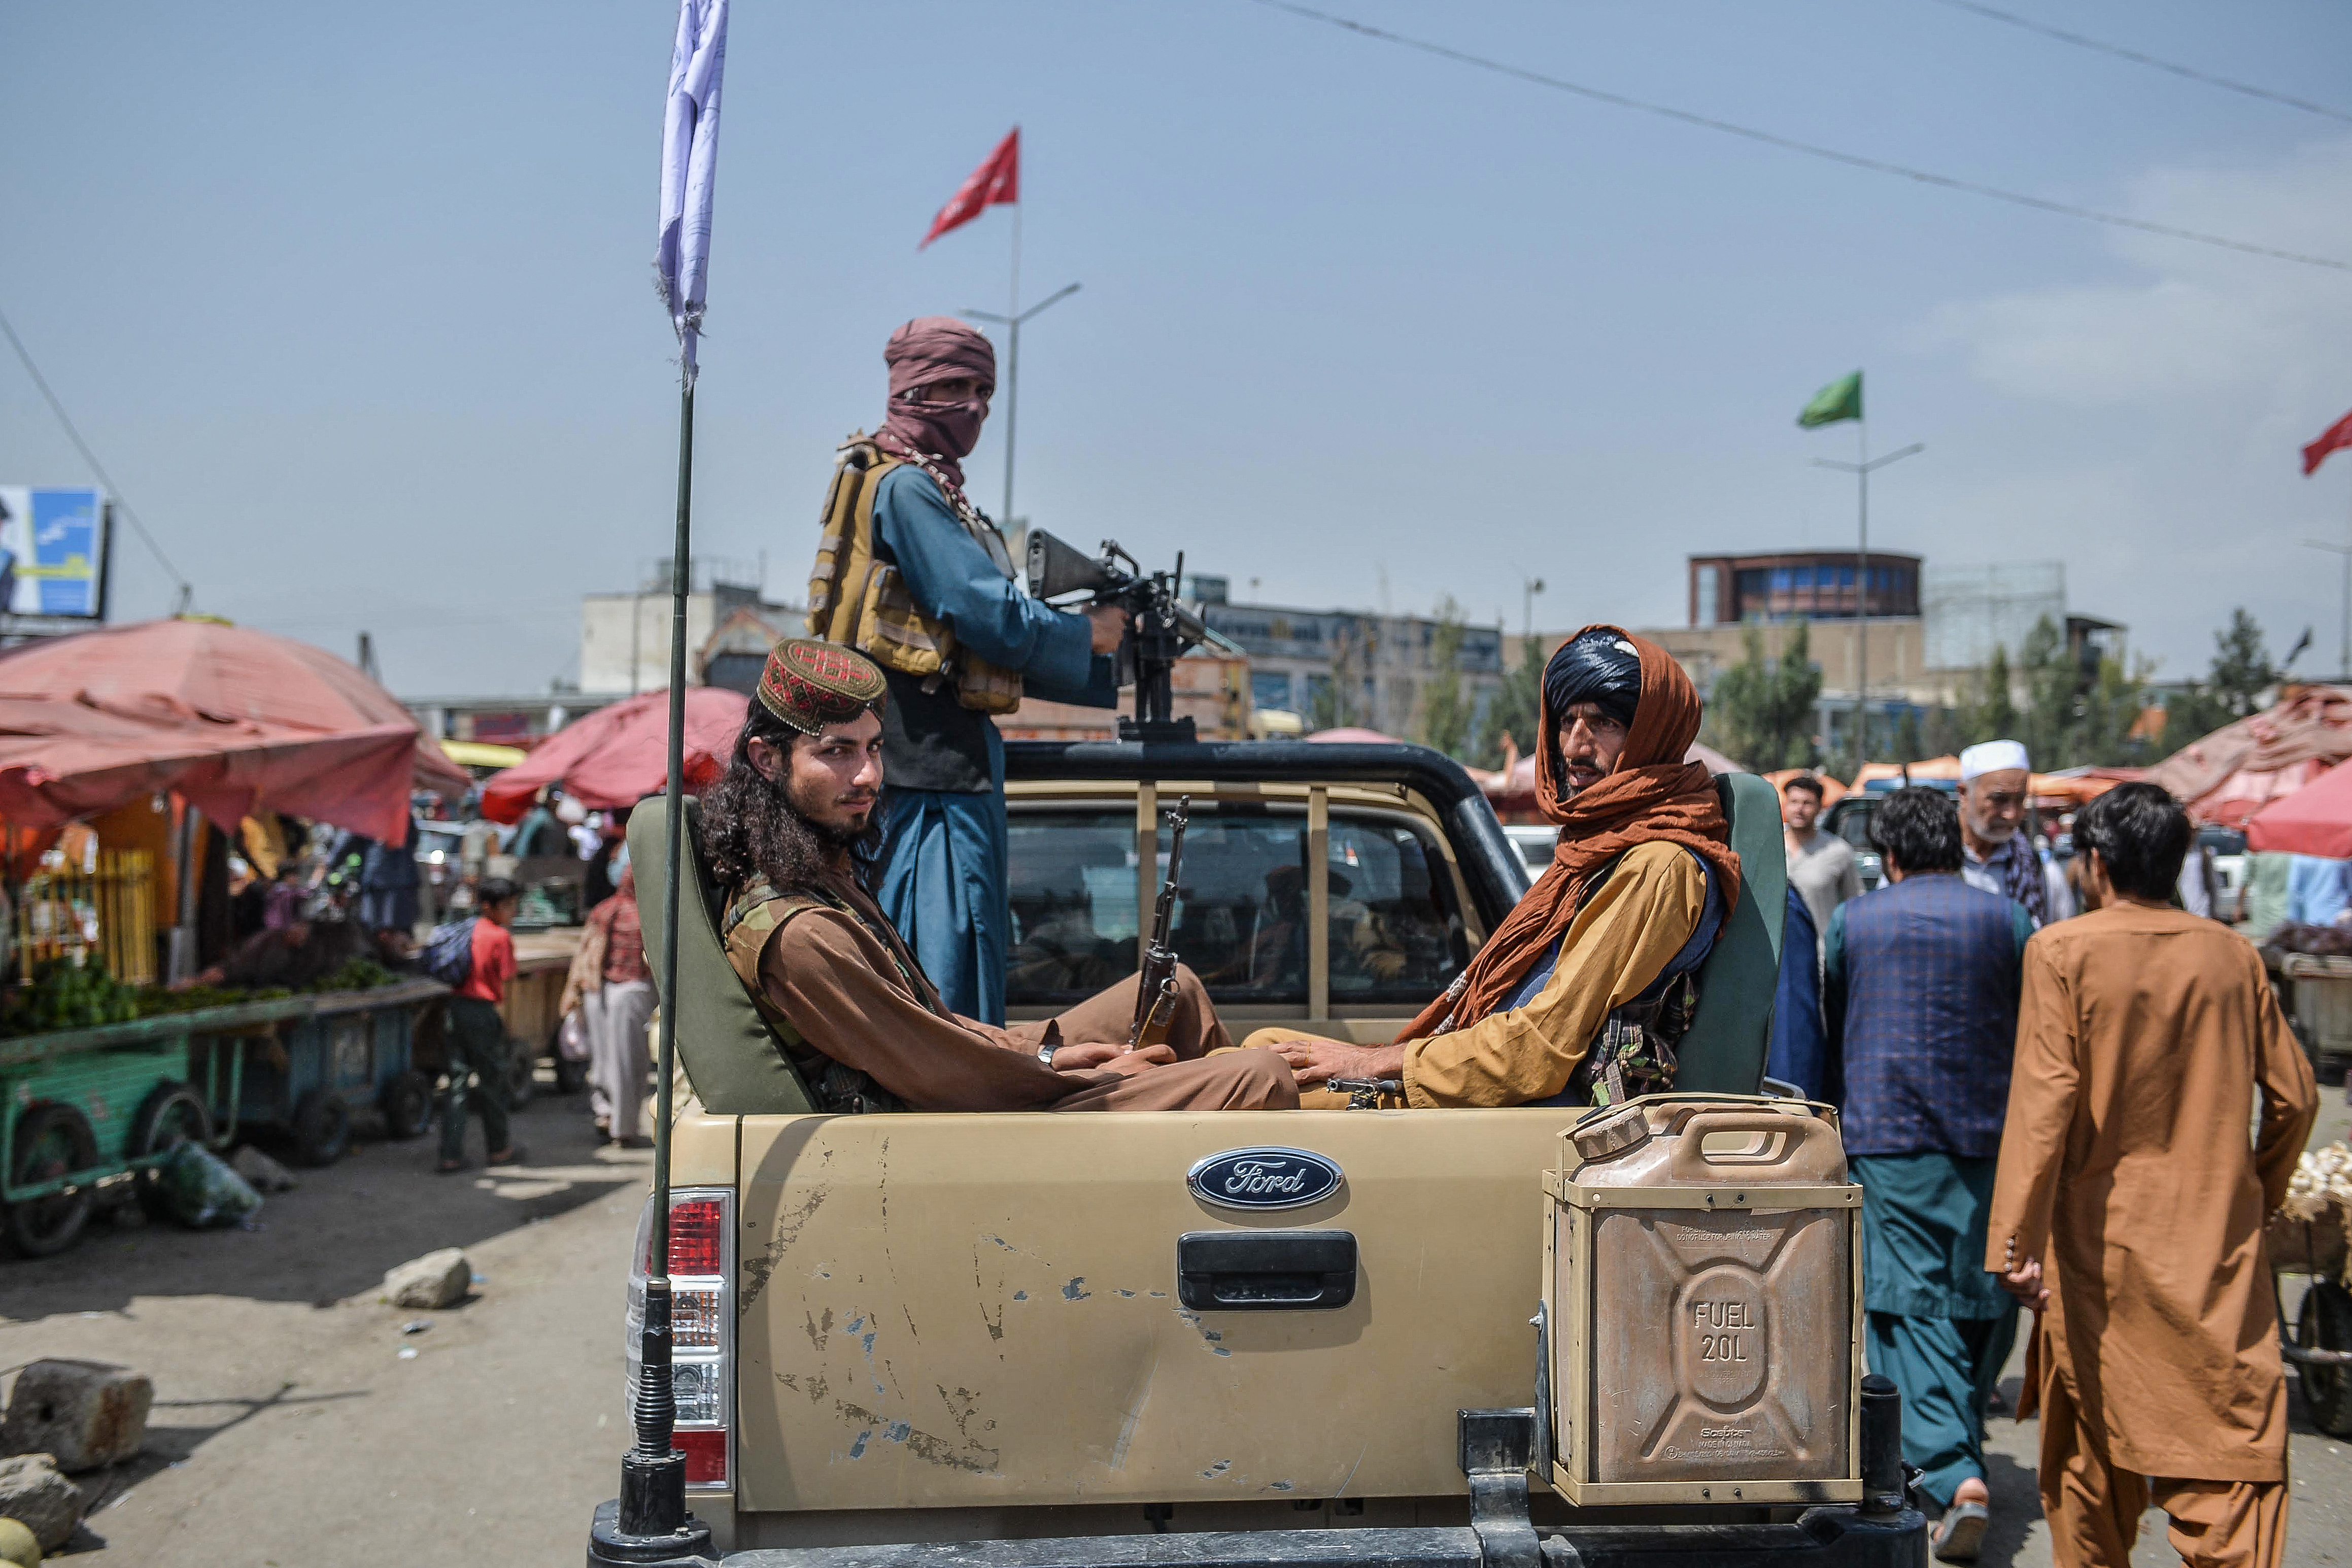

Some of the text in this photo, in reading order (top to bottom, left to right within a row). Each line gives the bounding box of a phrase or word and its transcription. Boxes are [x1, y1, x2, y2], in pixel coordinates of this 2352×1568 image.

[1225, 1161, 1306, 1193] Ford
[1694, 1301, 1755, 1329] FUEL
[1701, 1335, 1748, 1361] 20L
